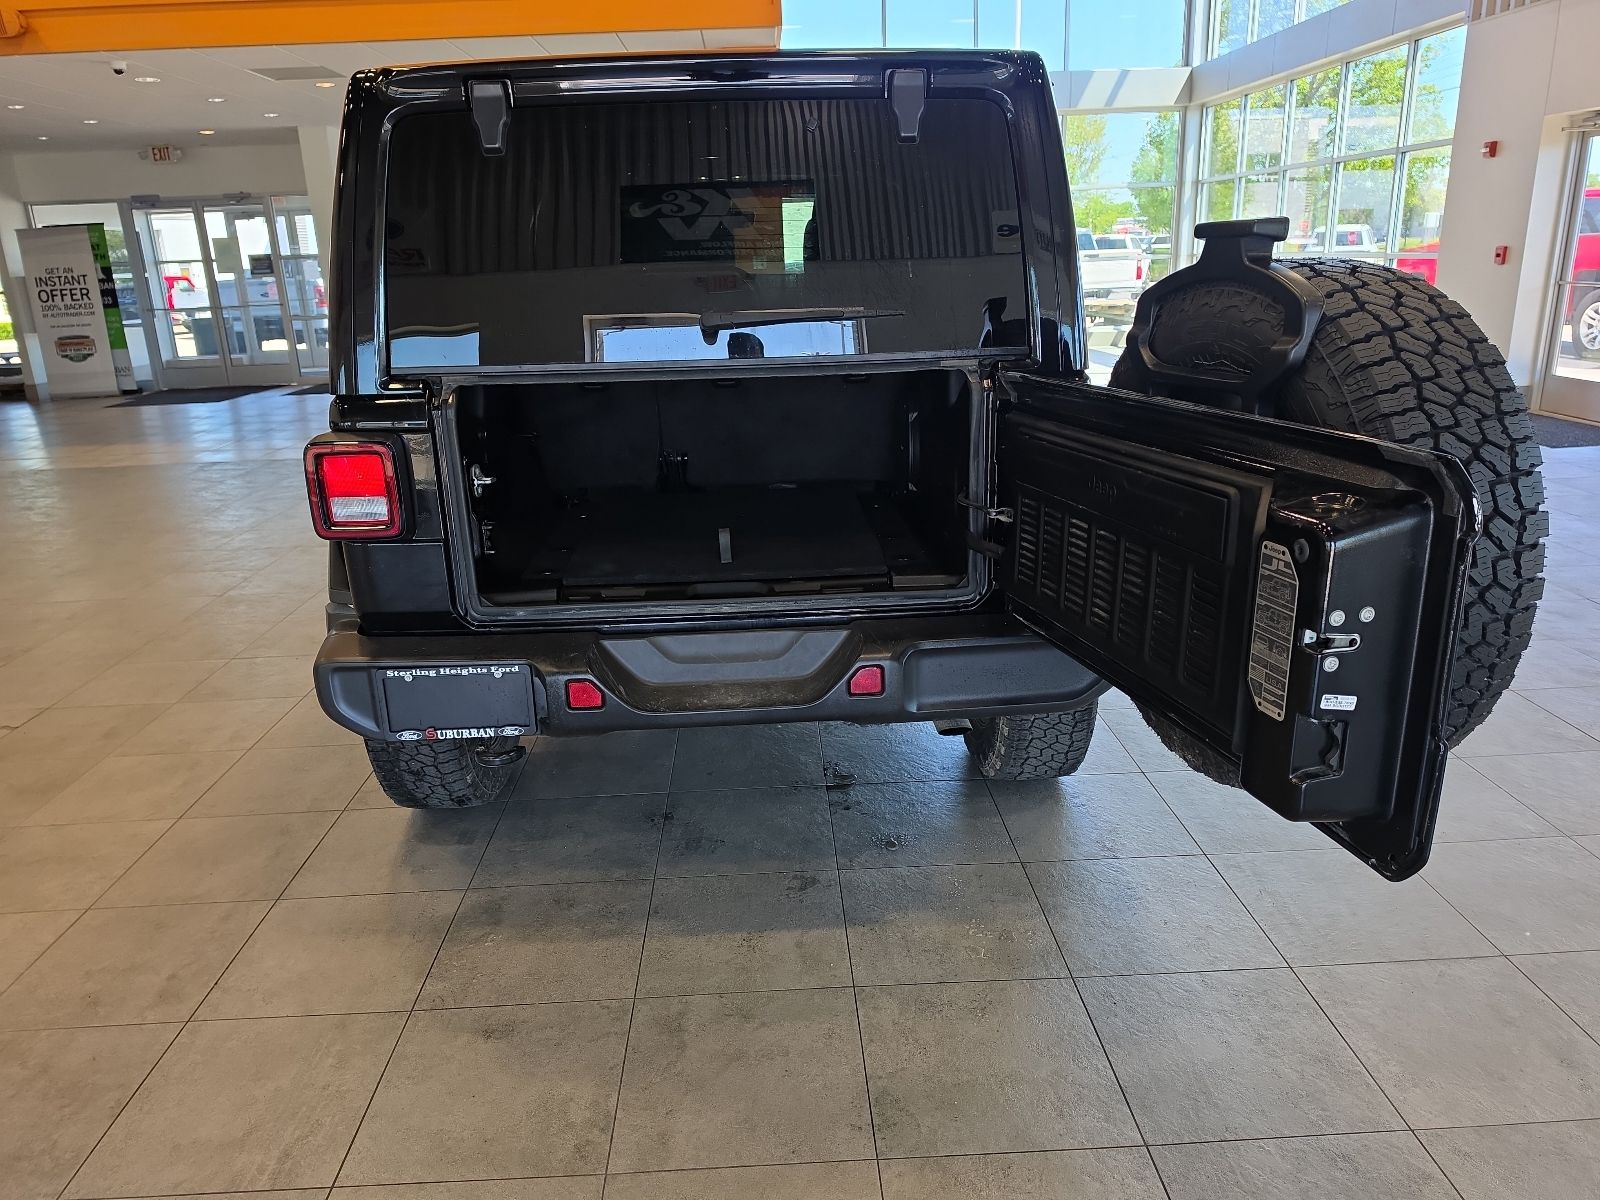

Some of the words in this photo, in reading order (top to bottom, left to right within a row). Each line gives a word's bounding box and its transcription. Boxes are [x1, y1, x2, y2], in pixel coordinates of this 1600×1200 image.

[152, 147, 170, 161] EXIT
[44, 267, 59, 275] GET
[63, 266, 74, 274] AN
[34, 274, 88, 288] INSTANT
[38, 287, 91, 303] OFFER
[40, 304, 62, 313] 100%
[63, 302, 94, 312] BACKED
[1087, 472, 1118, 504] Jeep
[1269, 545, 1282, 556] Jeep
[1261, 557, 1293, 575] JL
[386, 667, 437, 678] Sterling
[439, 667, 488, 676] Heights
[490, 665, 520, 674] Ford
[399, 731, 420, 740] Ford
[425, 727, 495, 741] SUBURBAN
[499, 727, 523, 736] Ford
